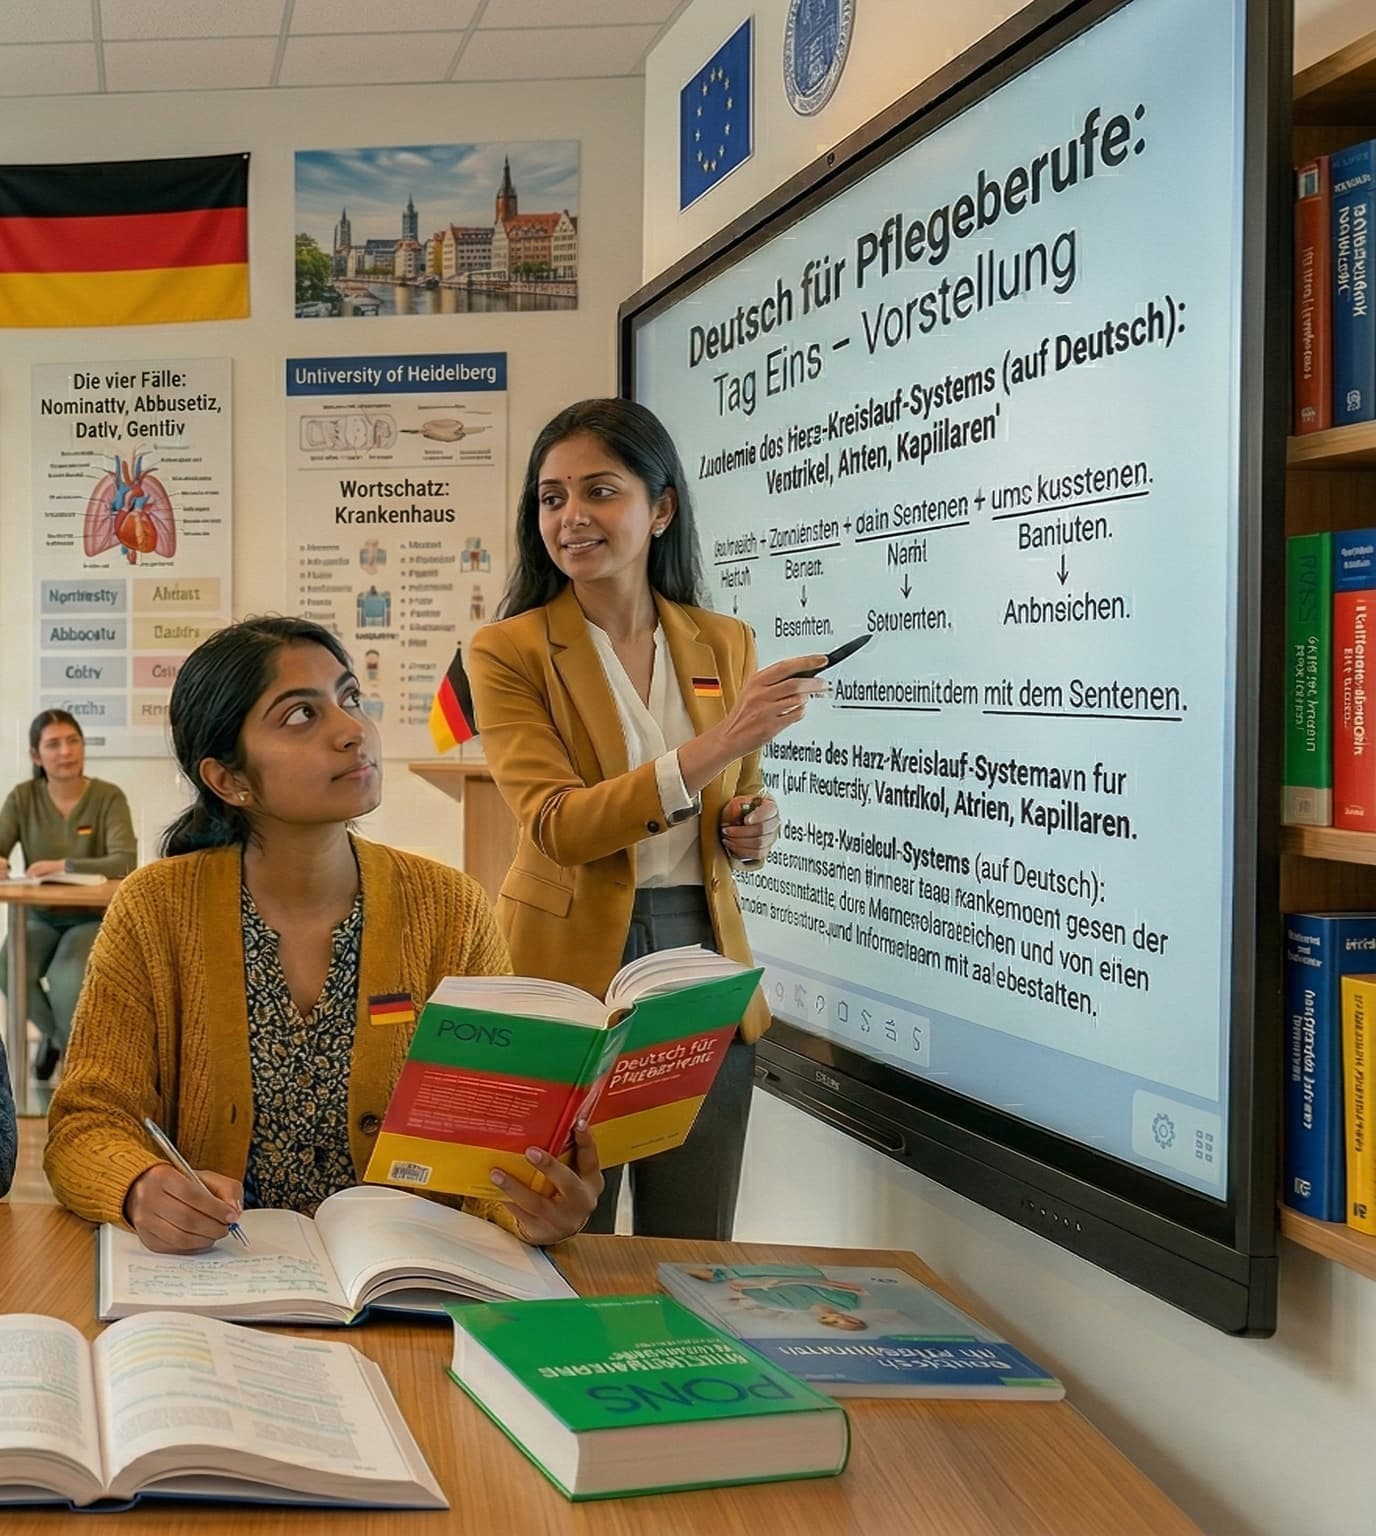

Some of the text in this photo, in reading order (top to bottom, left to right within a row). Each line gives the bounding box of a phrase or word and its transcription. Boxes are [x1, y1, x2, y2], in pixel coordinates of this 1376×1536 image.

[689, 103, 1146, 368] Deutsch für Pflegeberufe:
[713, 370, 757, 416] Tag
[767, 343, 822, 397] Eins
[861, 229, 1076, 354] Vorstellung
[1002, 337, 1049, 396] (auf
[1055, 295, 1186, 372] Deutsch):
[74, 370, 186, 390] Die vier Fälle:
[386, 365, 404, 381] of
[408, 363, 497, 384] Heidelberg
[339, 478, 449, 498] Wortschatz:
[1037, 462, 1153, 503] kusstenen.
[335, 504, 456, 524] Krankenhaus
[984, 678, 1014, 706] mit
[1019, 678, 1063, 707] dem
[1069, 679, 1188, 711] Sentenen.
[825, 740, 849, 767] des
[1093, 762, 1127, 795] fur
[953, 789, 1015, 828] Atrien,
[1020, 796, 1138, 840] Kapillaren.
[975, 851, 1010, 884] (auf
[1013, 860, 1105, 907] Deutsch):
[1067, 913, 1126, 946] gesen
[1132, 922, 1169, 955] der
[944, 952, 969, 979] mit
[1020, 939, 1054, 966] und
[1059, 949, 1093, 977] von
[436, 1018, 513, 1048] PONS
[585, 1373, 796, 1415] PONS
